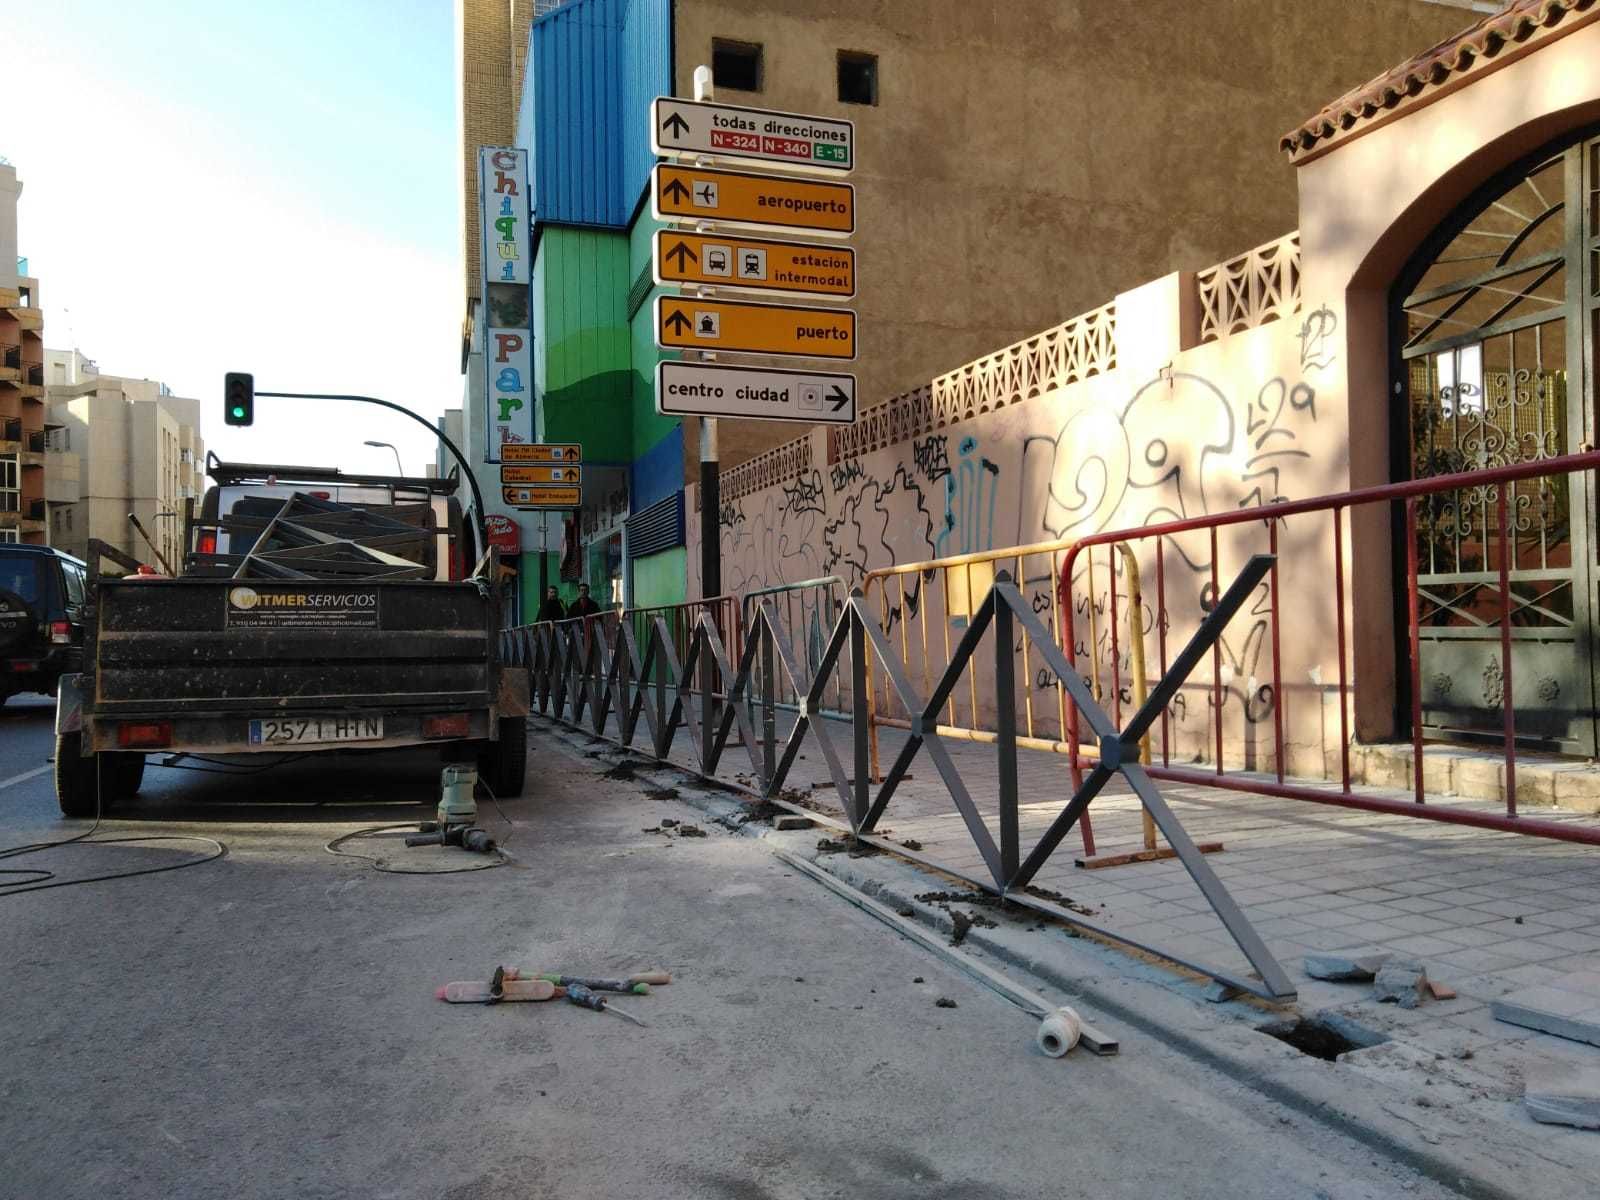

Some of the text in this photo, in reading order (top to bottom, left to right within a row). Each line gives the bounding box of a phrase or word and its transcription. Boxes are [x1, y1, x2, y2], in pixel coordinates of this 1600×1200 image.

[713, 114, 847, 142] todas direcciones
[713, 133, 758, 151] N-324
[764, 138, 809, 156] N-340
[816, 146, 845, 160] E-15
[757, 196, 846, 214] aeropuerto
[774, 269, 849, 288] intermodal
[796, 326, 849, 341] puerto
[668, 382, 789, 403] centro ciudad
